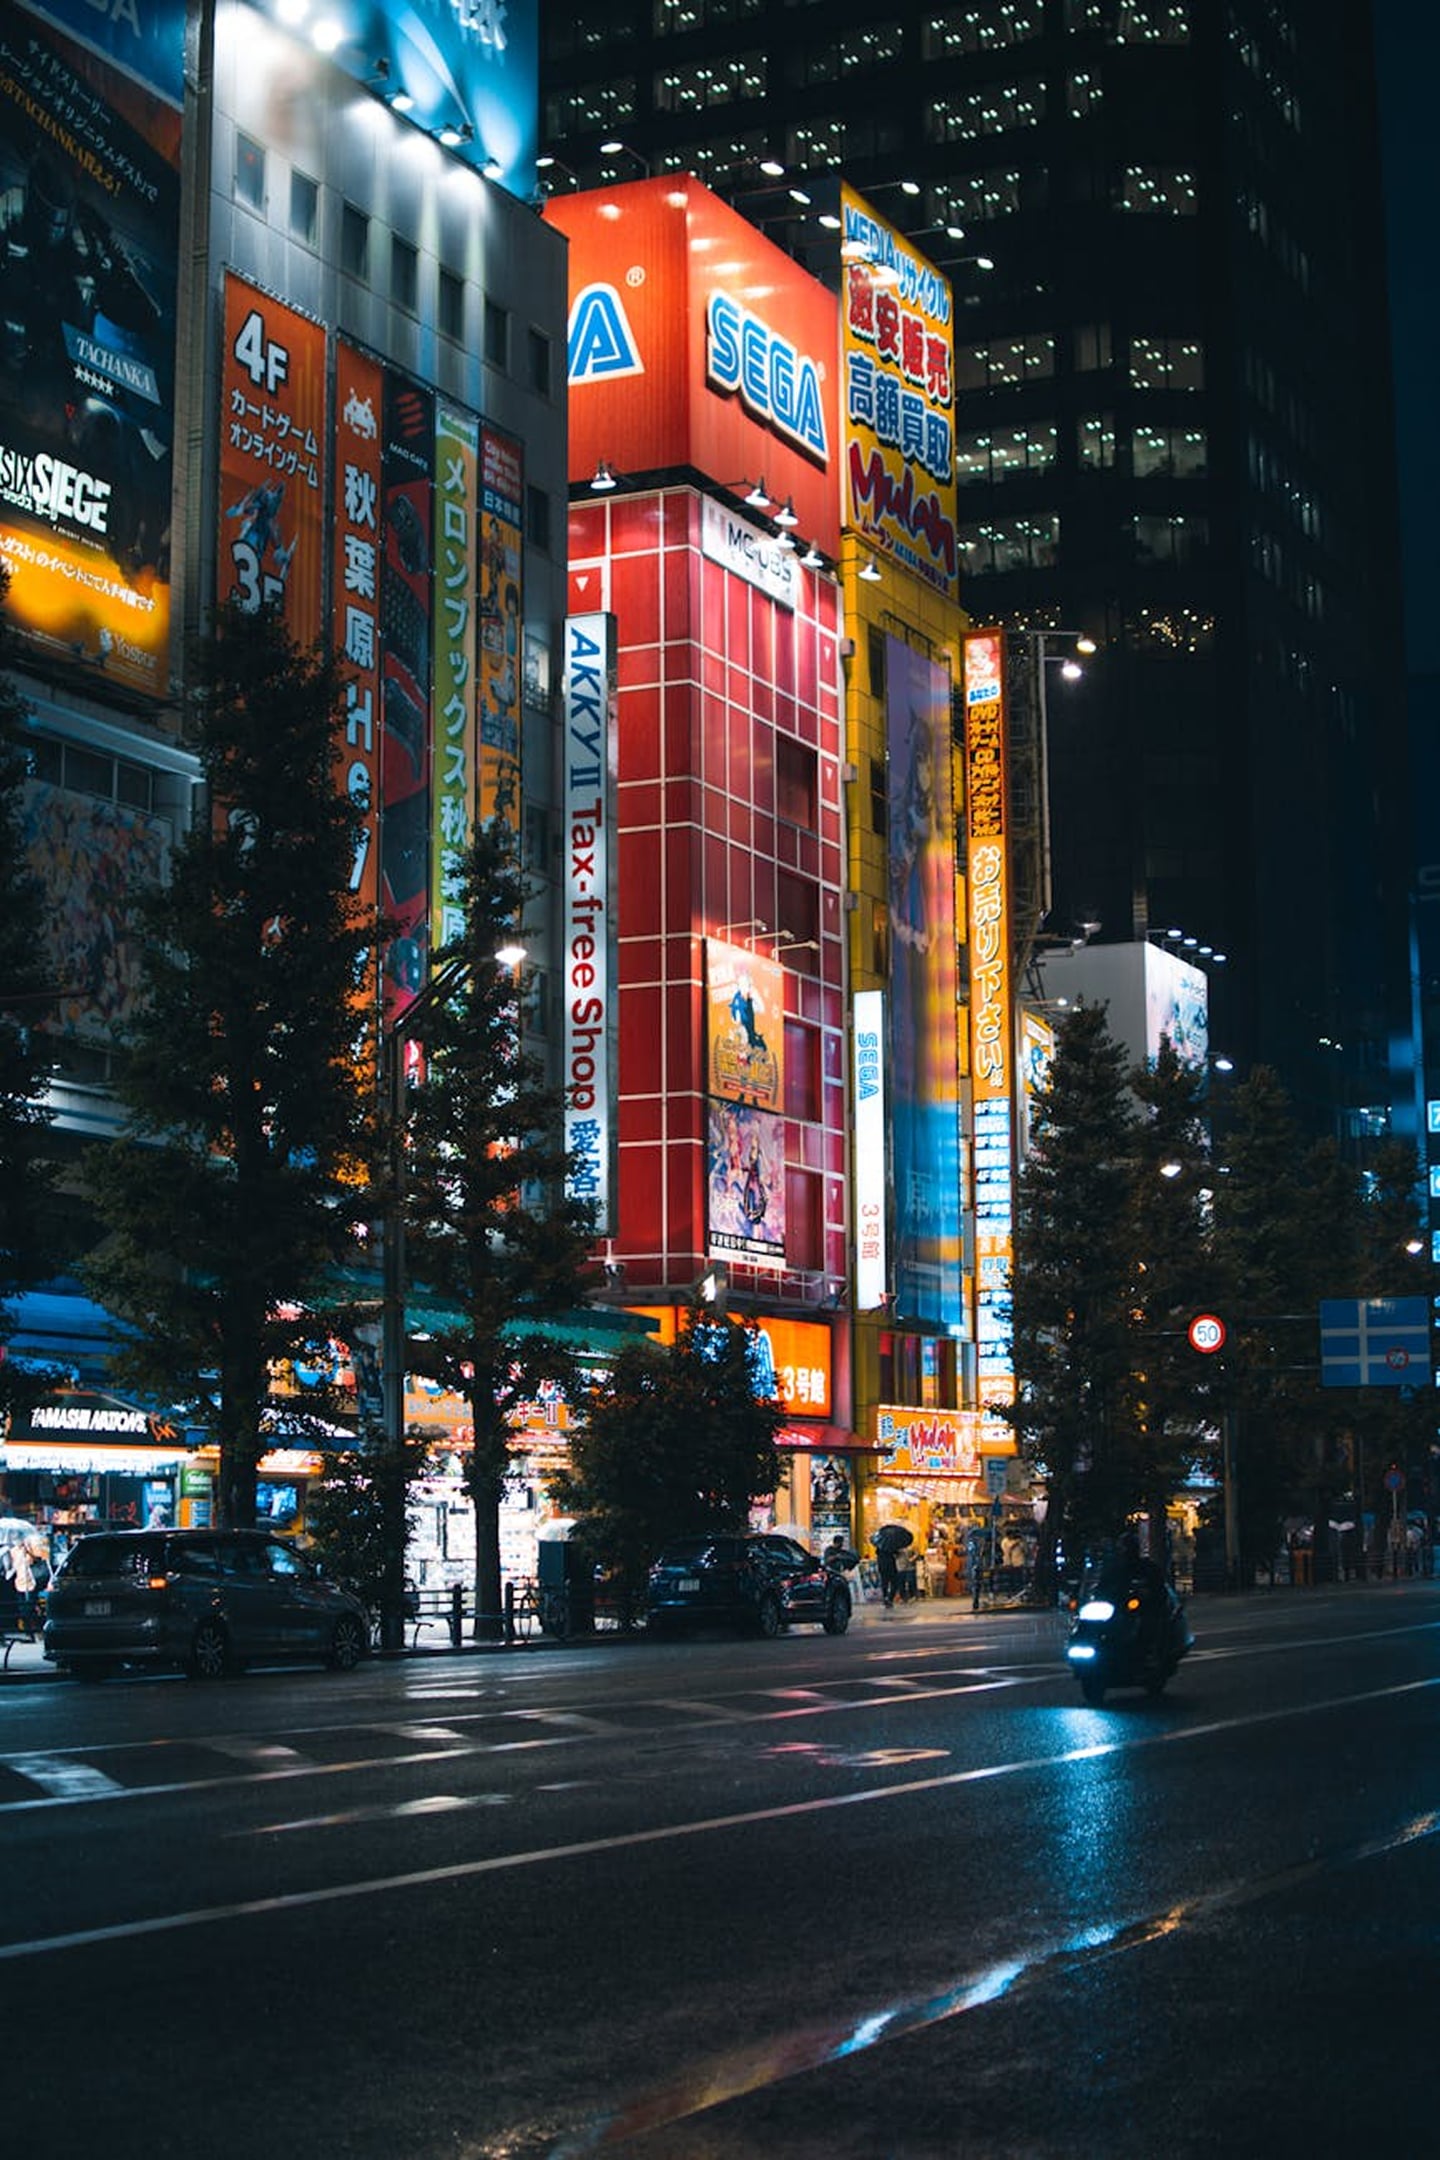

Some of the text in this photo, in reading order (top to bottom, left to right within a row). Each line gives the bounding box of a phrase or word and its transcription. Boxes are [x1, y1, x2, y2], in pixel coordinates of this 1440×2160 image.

[76, 336, 151, 392] TACHANKA
[234, 311, 289, 394] 4F
[709, 289, 829, 461] SEGA
[230, 388, 318, 457] カードゲーム
[230, 421, 319, 489] オンラインゲーム
[848, 352, 951, 480] 高額買取
[33, 452, 112, 534] SIEGE
[848, 442, 957, 580] Mulan
[343, 464, 376, 669] 秋葉原
[570, 627, 601, 760] AKKY
[570, 797, 603, 988] Tax-free
[570, 997, 602, 1110] Shop
[857, 1031, 879, 1101] SEGA
[861, 1204, 880, 1260] 3号館
[1197, 1323, 1220, 1343] 50
[31, 1407, 91, 1429] TAMASHII
[783, 1365, 825, 1404] 3号館
